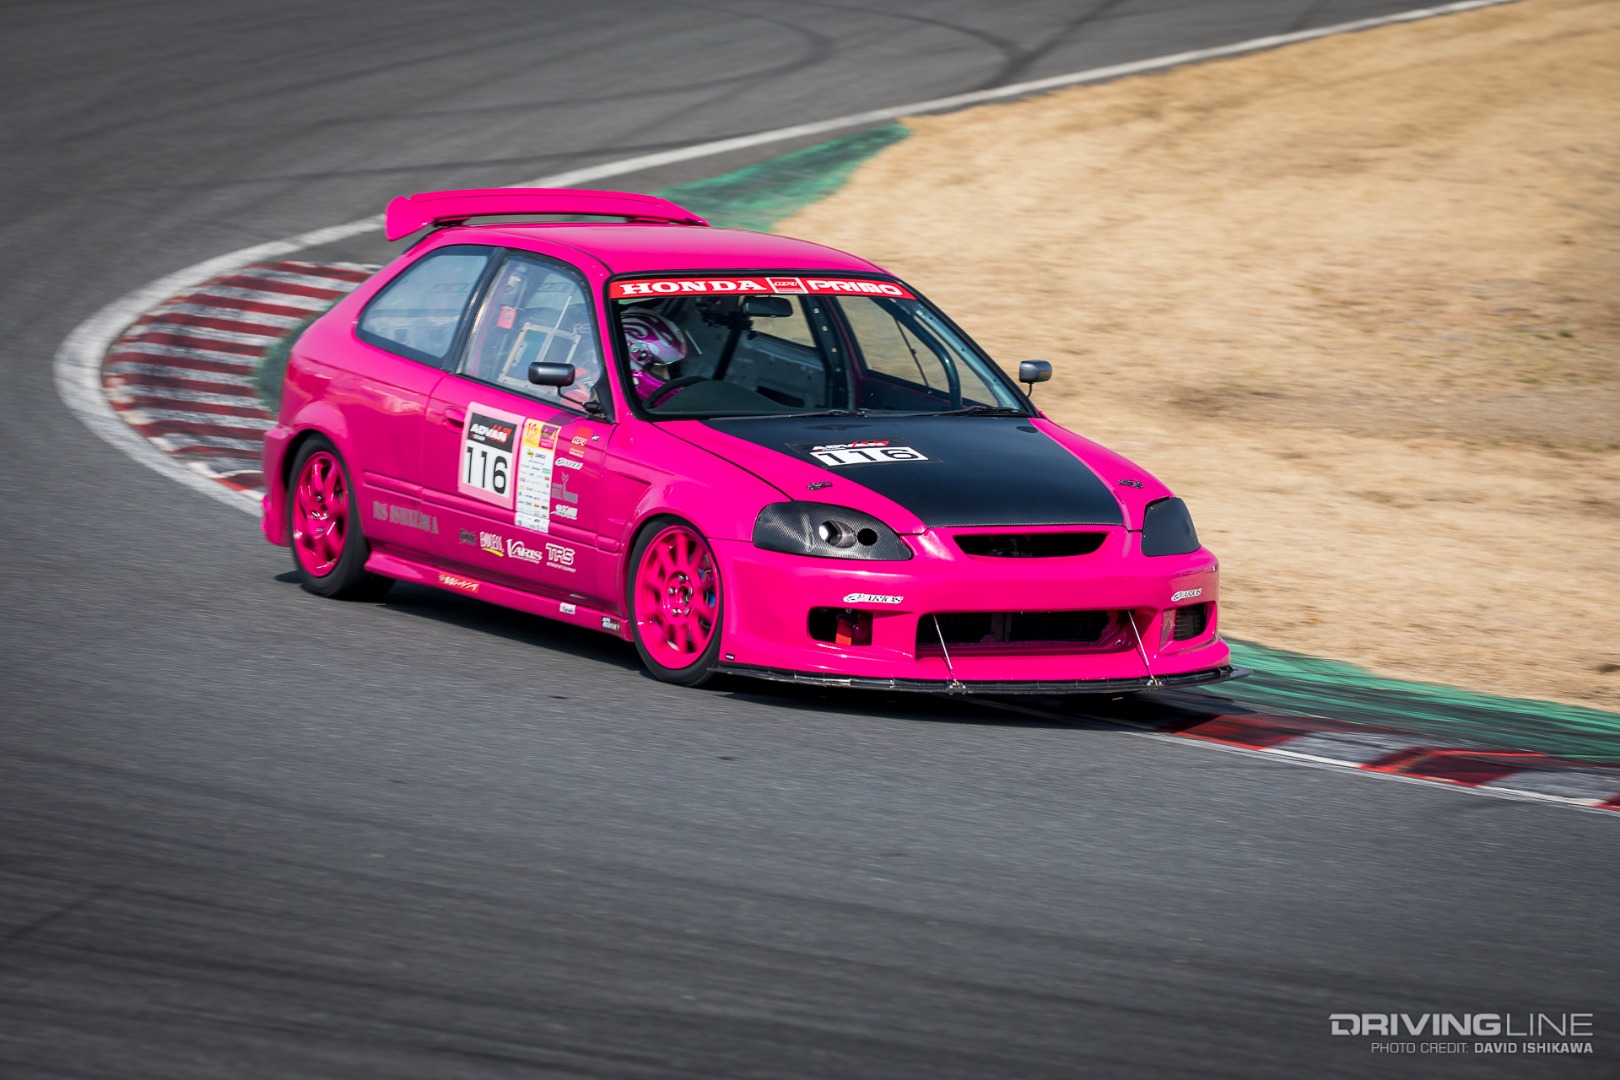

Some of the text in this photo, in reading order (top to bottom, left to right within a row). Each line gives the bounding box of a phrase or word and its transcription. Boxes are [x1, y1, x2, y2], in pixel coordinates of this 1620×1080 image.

[619, 280, 767, 295] HONDA
[805, 279, 903, 296] PRIMO
[469, 423, 508, 443] ADVAN
[817, 449, 920, 464] 116
[466, 446, 508, 495] 116
